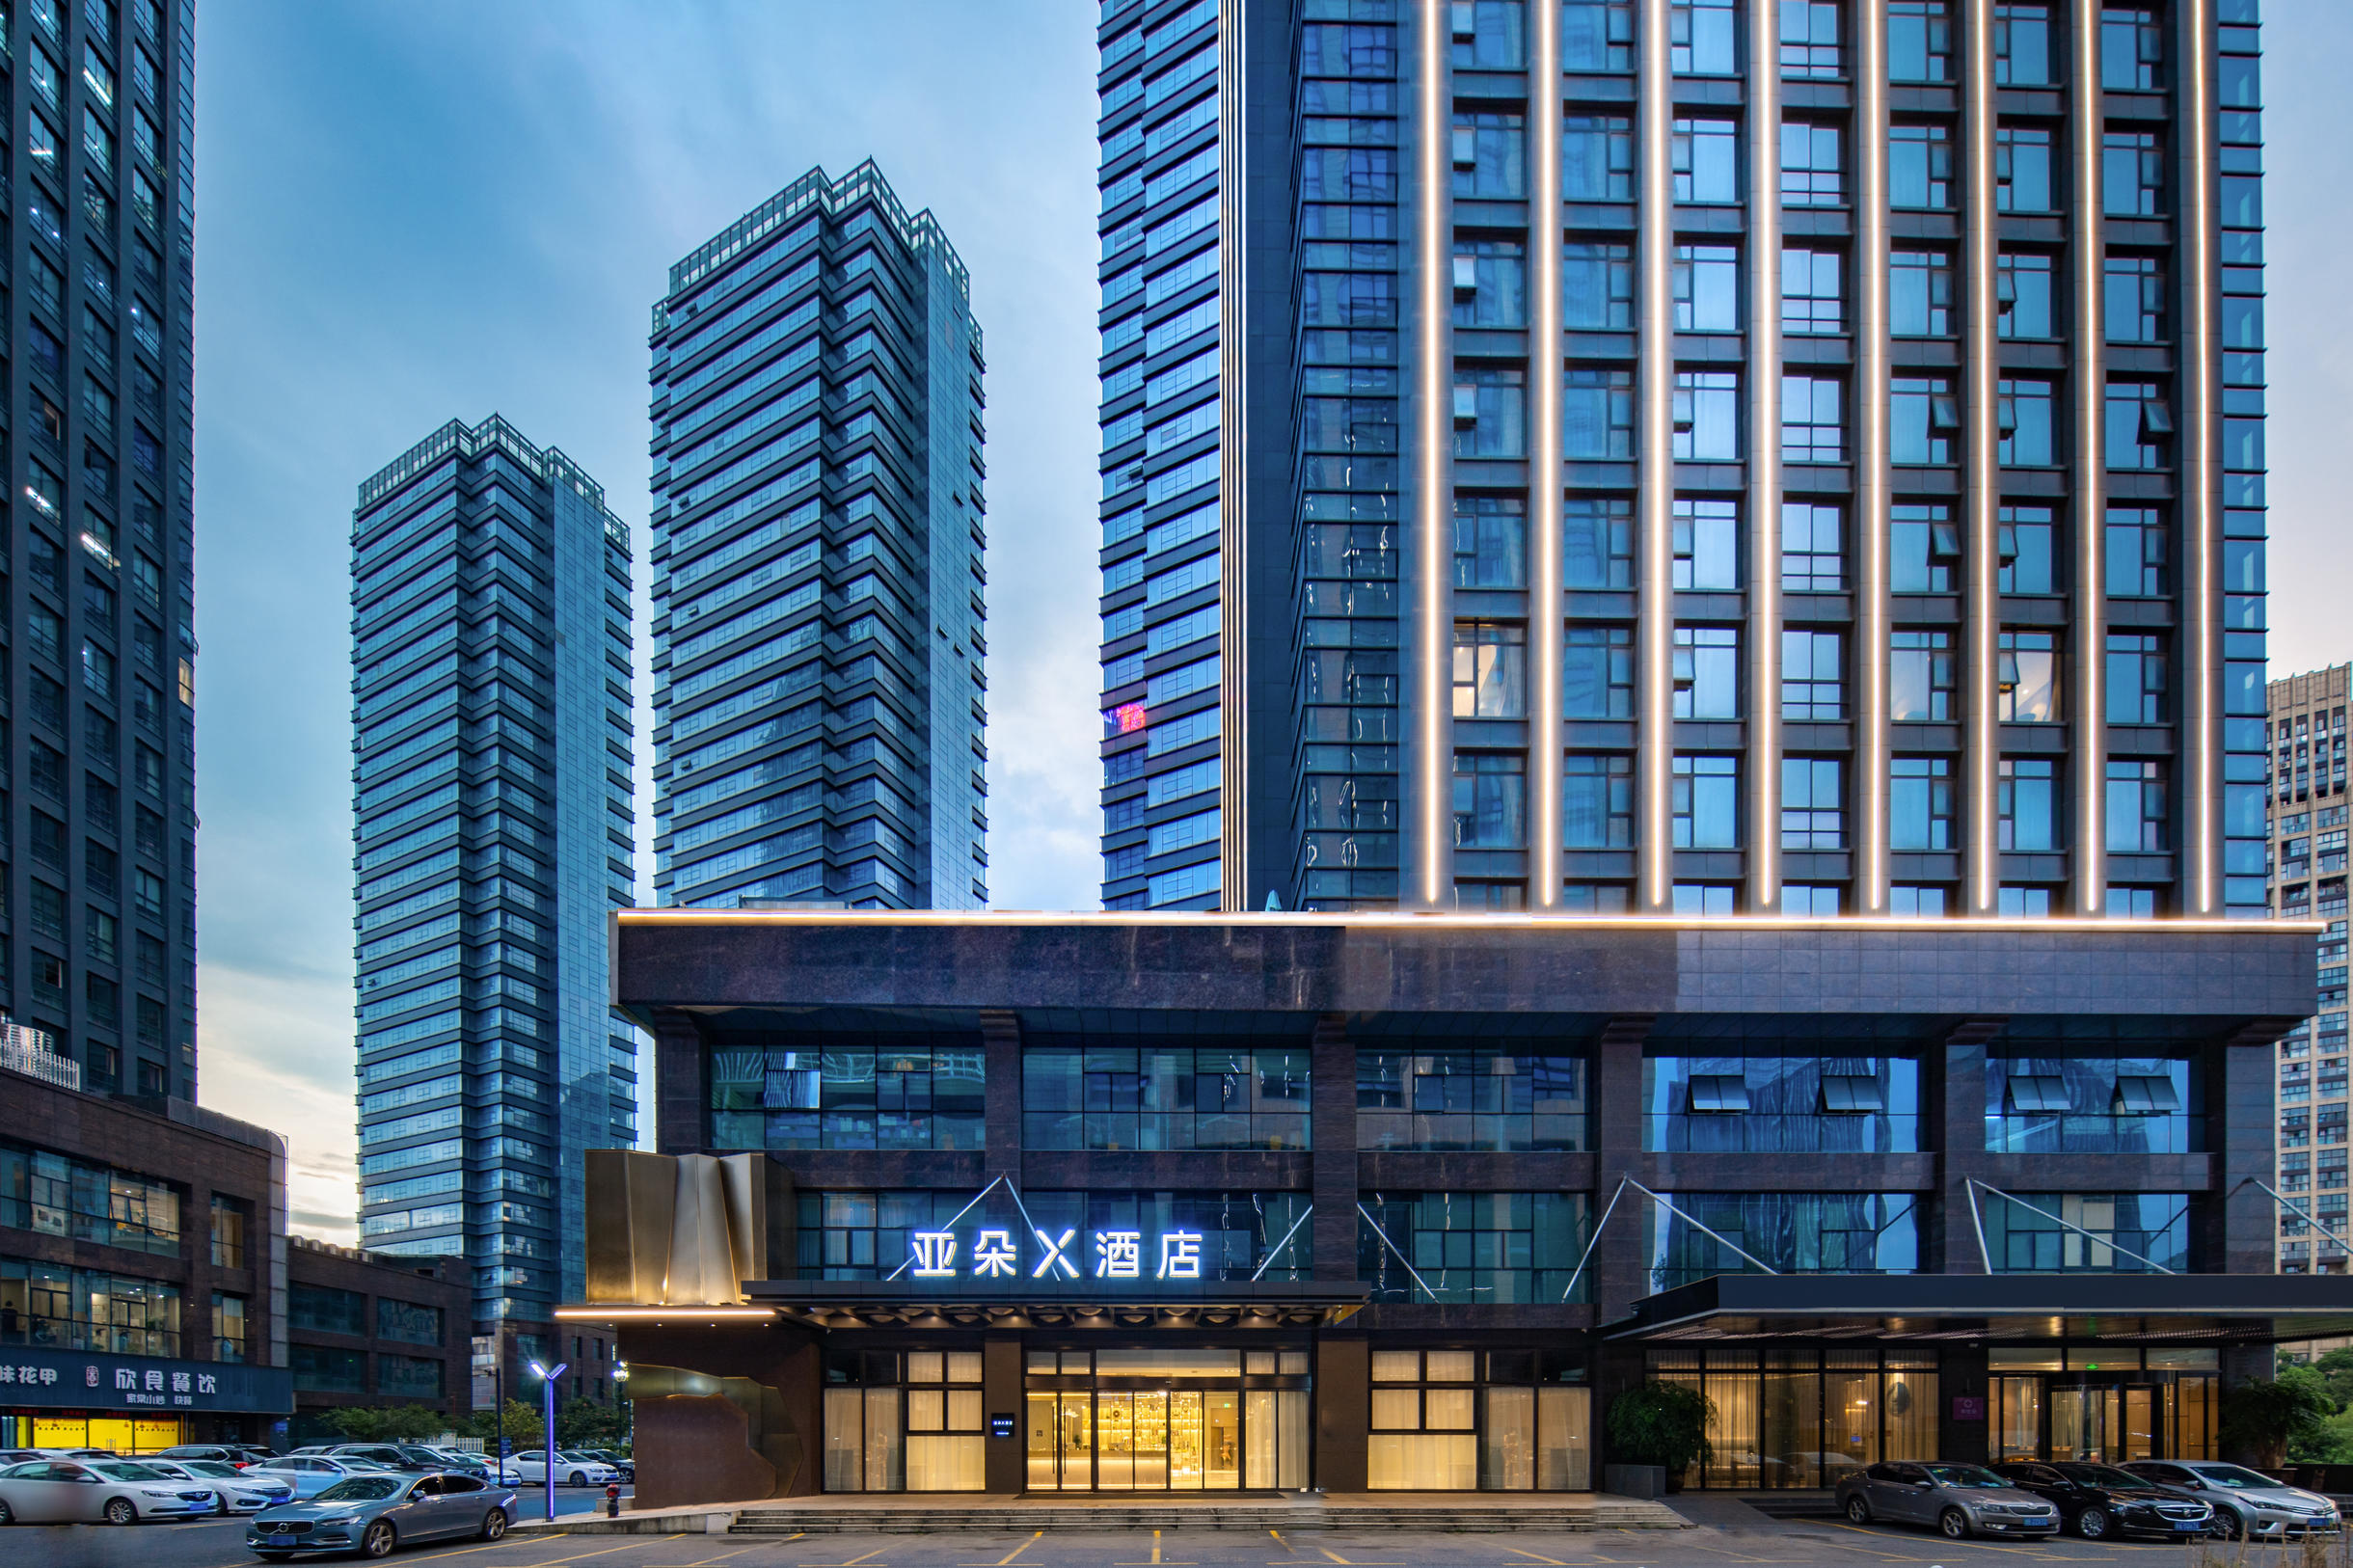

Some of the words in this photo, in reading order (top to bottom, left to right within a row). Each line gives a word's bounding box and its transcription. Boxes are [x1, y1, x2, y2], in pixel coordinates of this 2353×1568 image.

[911, 1229, 1204, 1279] 亚朵X酒店
[115, 1367, 216, 1394] 欣食餐饮
